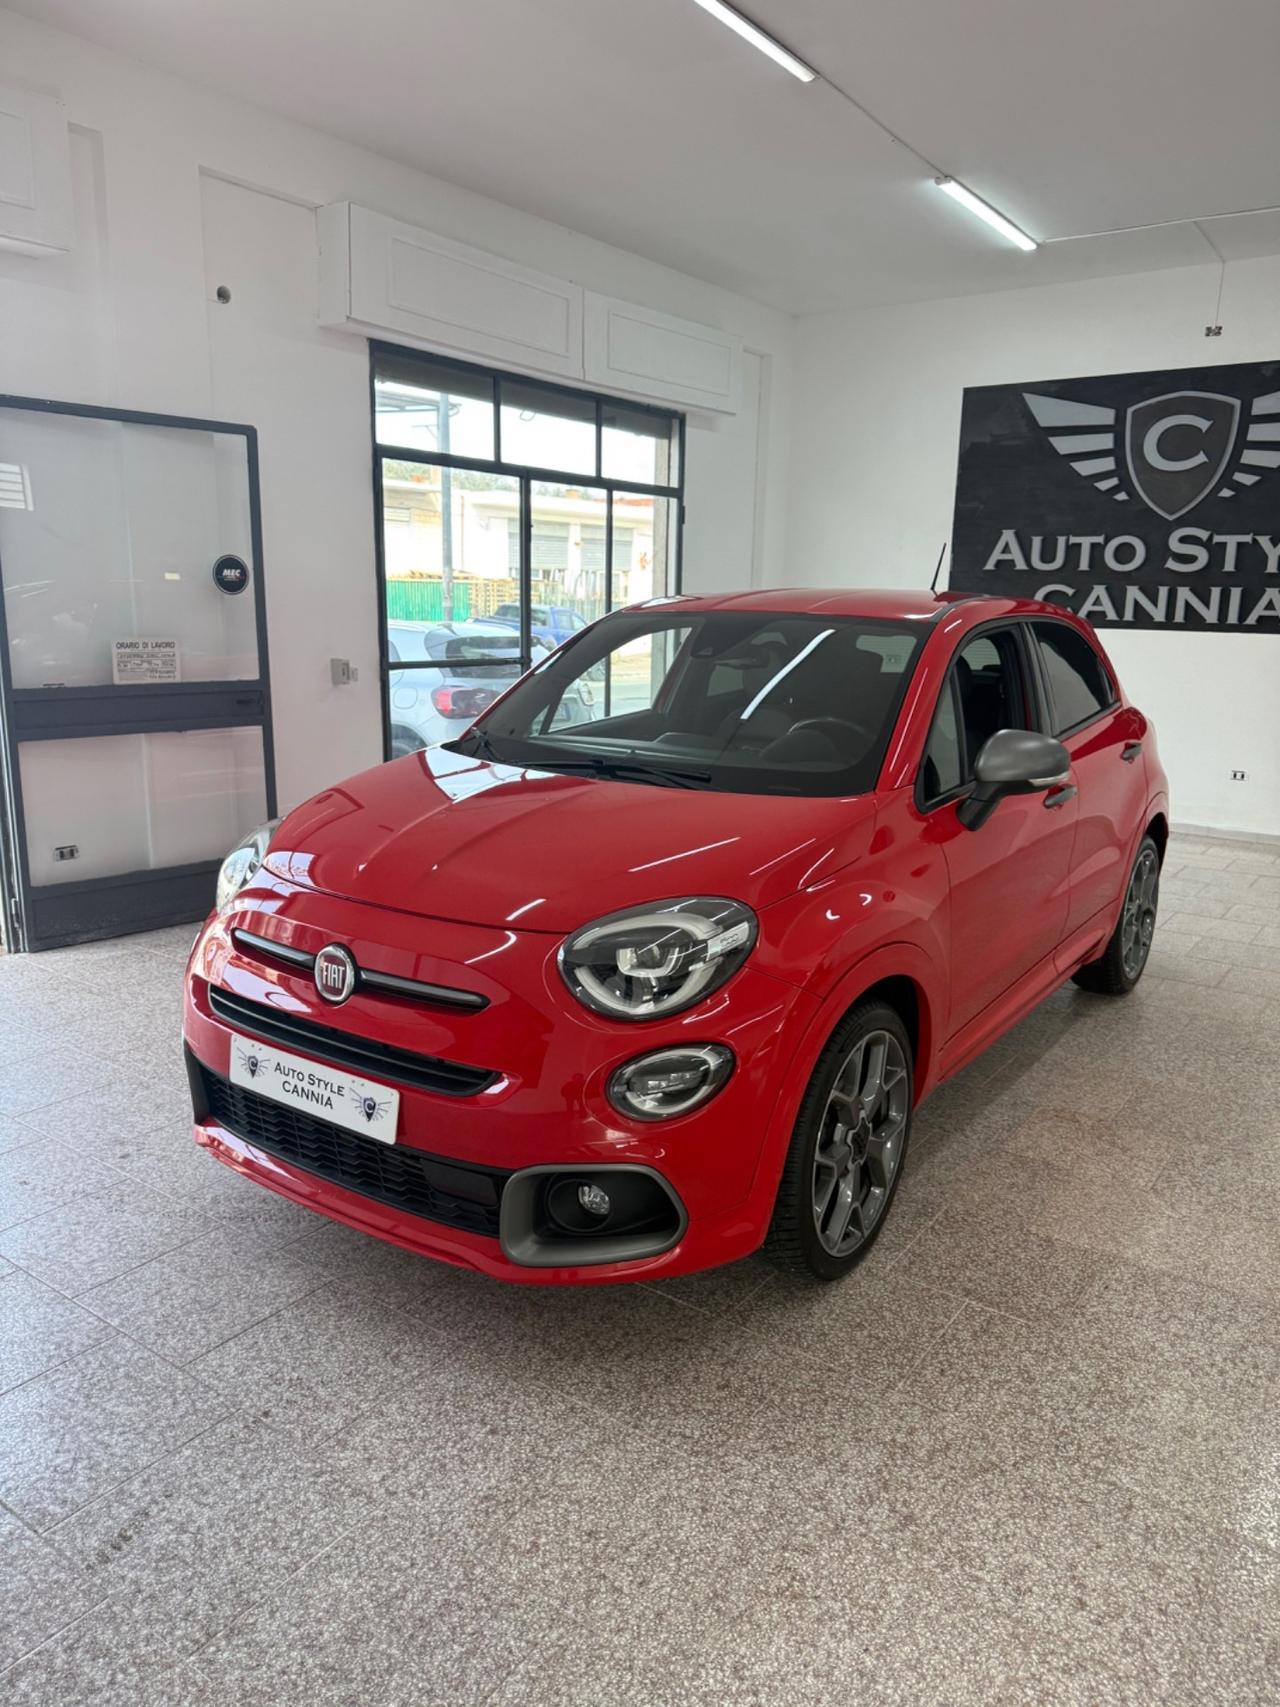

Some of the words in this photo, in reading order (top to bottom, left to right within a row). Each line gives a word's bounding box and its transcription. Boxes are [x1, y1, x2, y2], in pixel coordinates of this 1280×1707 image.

[1143, 414, 1214, 472] C
[983, 529, 1146, 572] AUTO
[223, 568, 241, 576] MEC
[322, 962, 345, 989] FIAT
[274, 1062, 305, 1082] AUTO
[307, 1073, 345, 1097] STYLE
[282, 1080, 333, 1109] CANNIA
